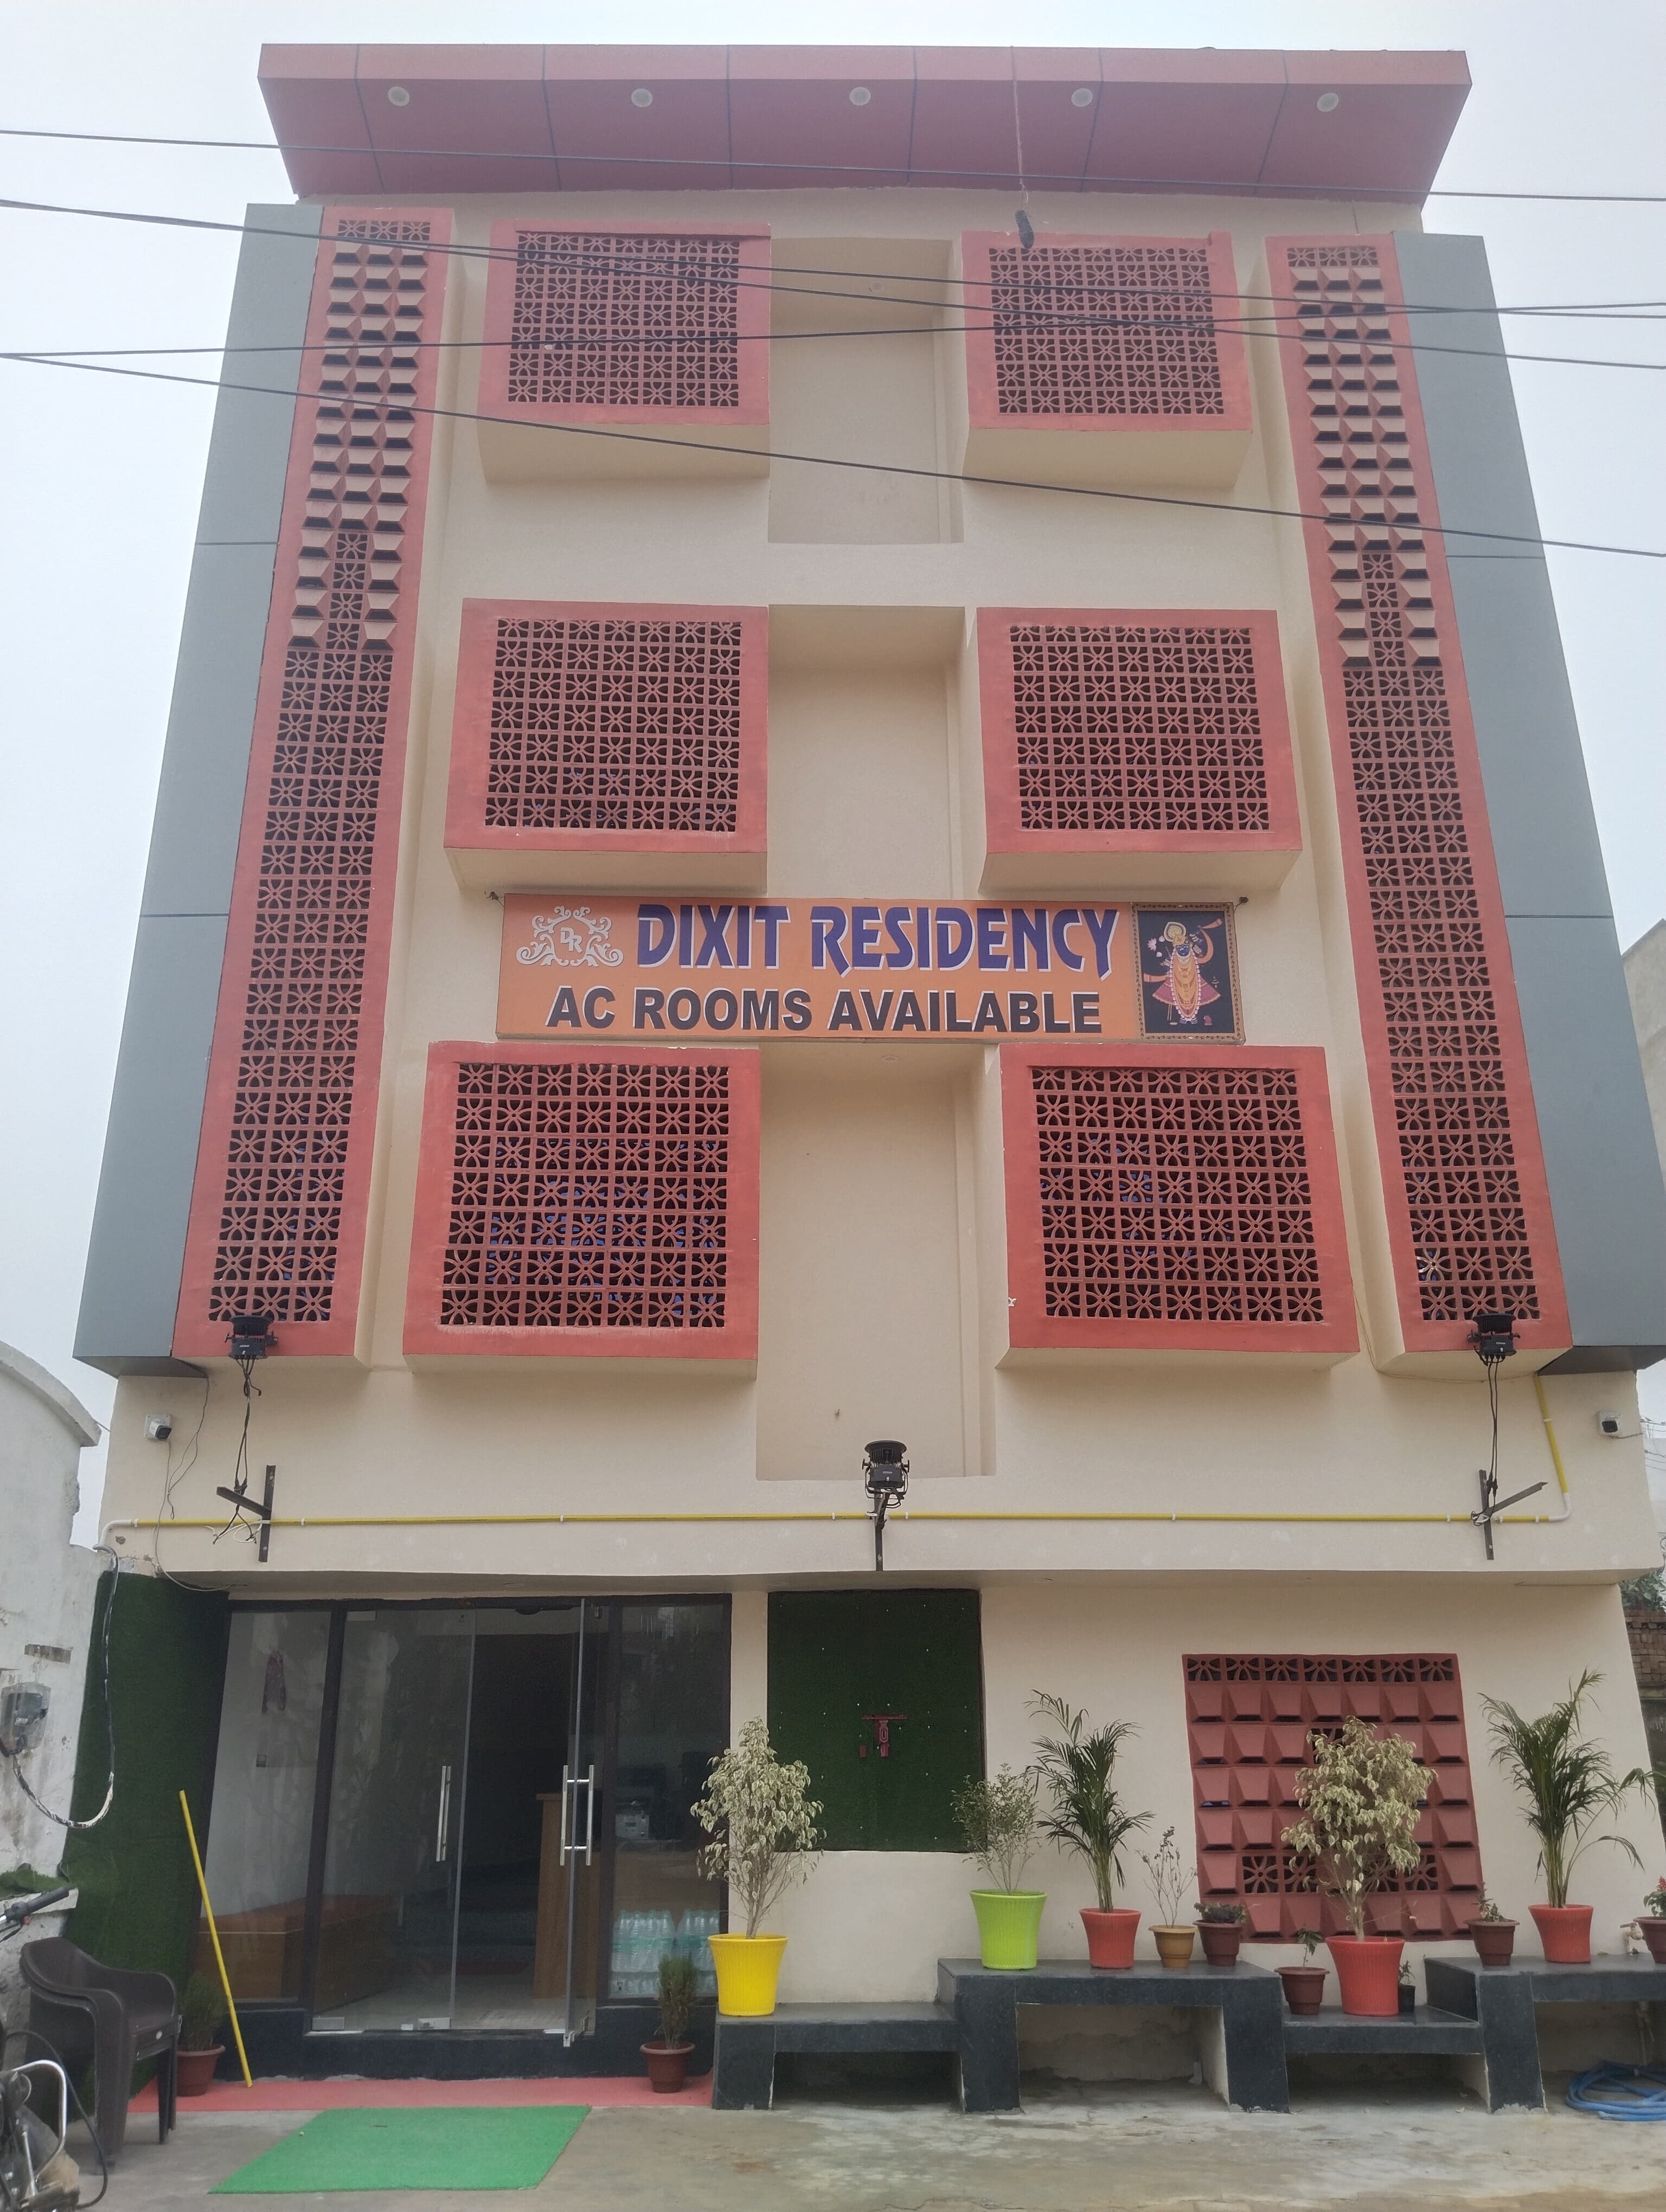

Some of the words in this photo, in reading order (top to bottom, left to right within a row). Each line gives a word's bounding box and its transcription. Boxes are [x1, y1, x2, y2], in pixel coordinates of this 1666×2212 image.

[560, 927, 583, 954] DR
[637, 904, 791, 969] DIXIT
[810, 906, 1120, 981] RESIDENCY
[545, 985, 616, 1028] AC
[632, 987, 812, 1031] ROOMS
[826, 988, 1102, 1034] AVAILABLE
